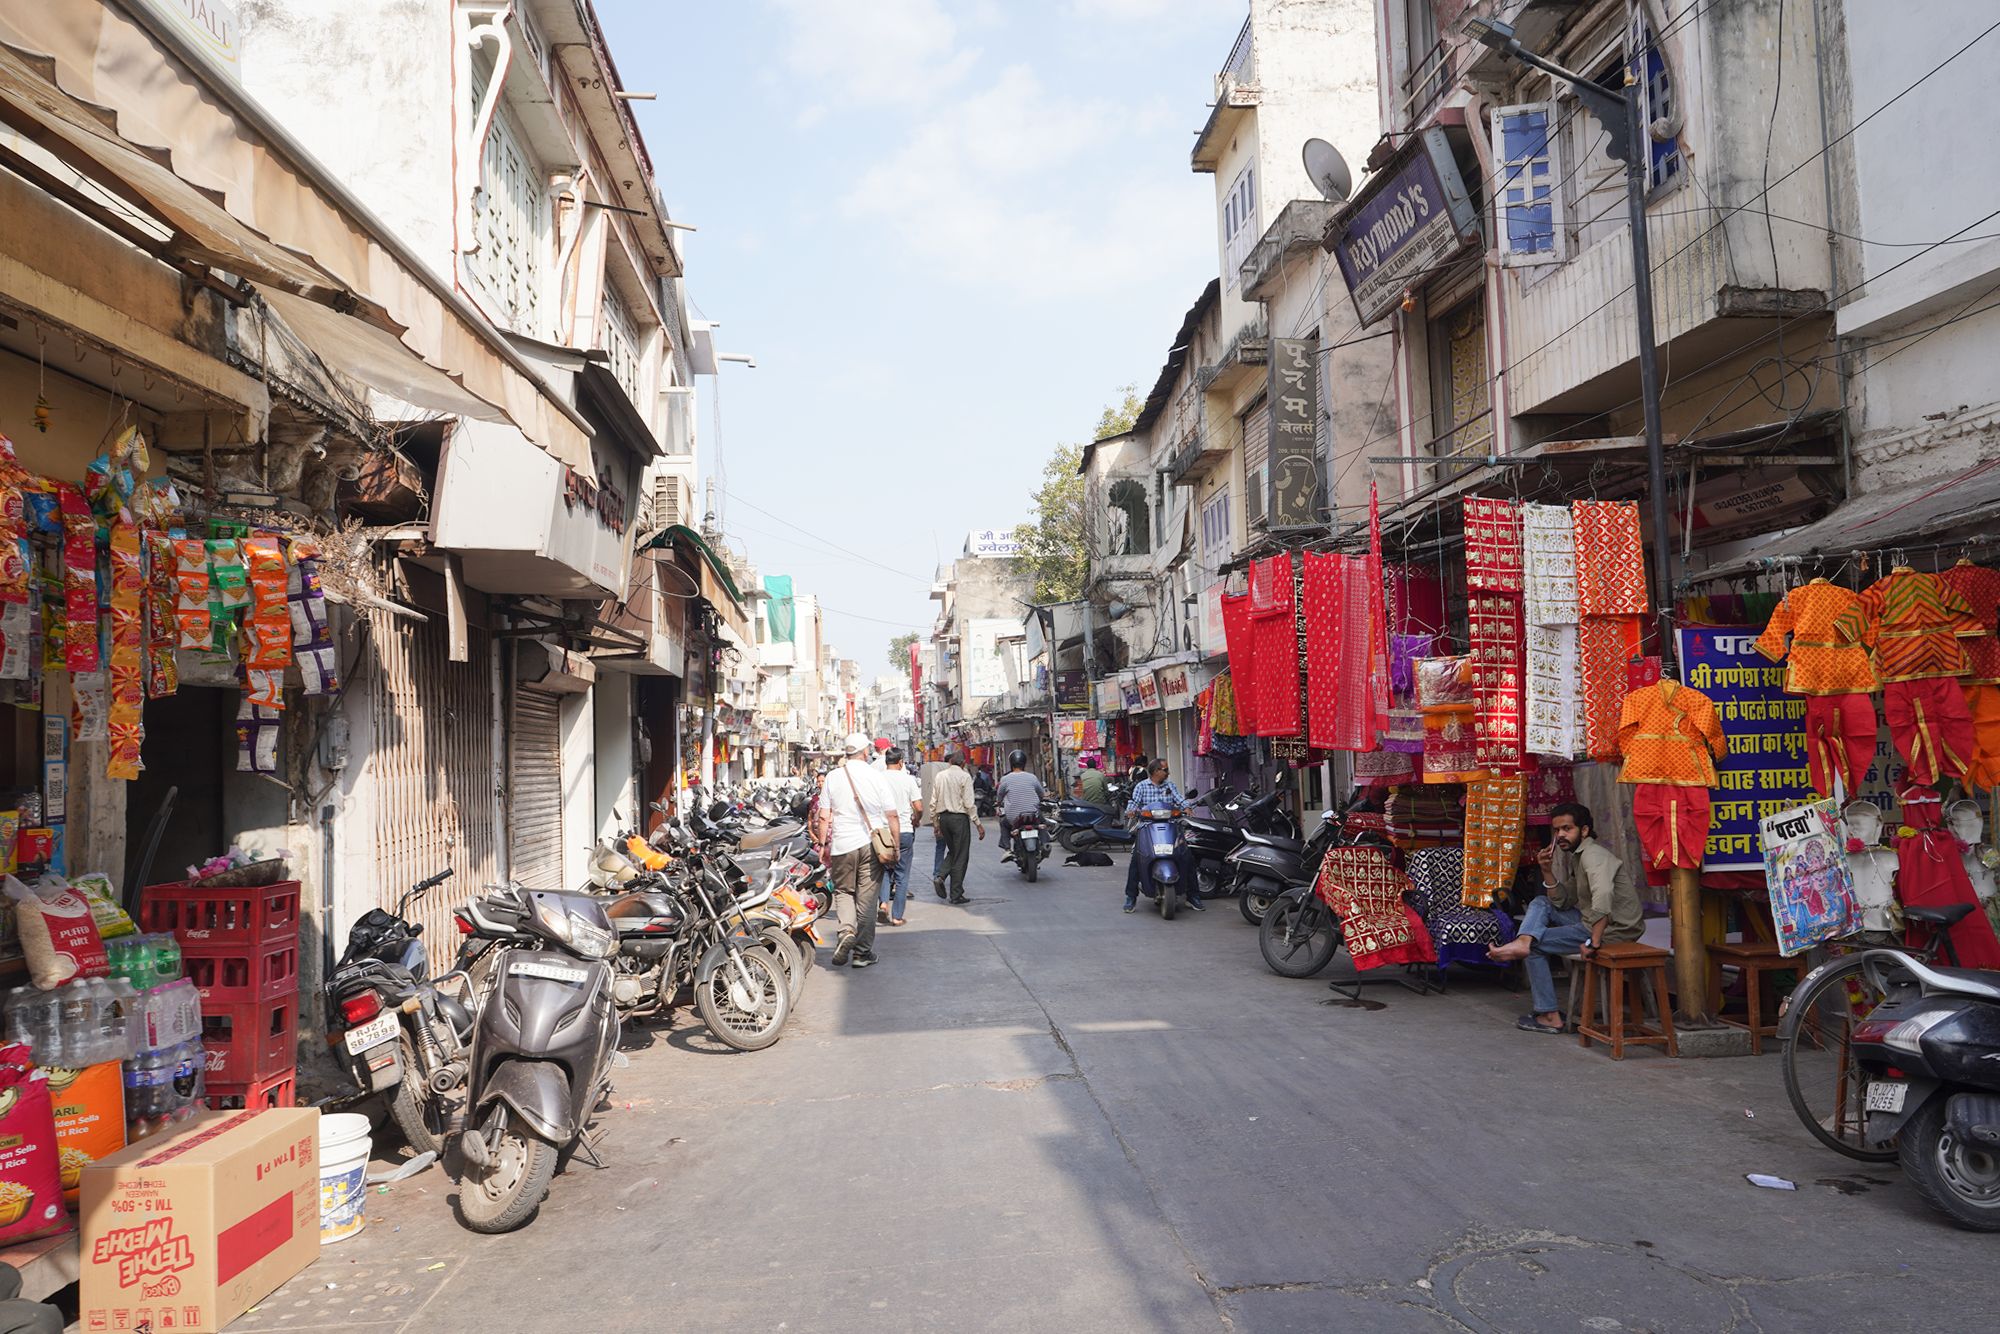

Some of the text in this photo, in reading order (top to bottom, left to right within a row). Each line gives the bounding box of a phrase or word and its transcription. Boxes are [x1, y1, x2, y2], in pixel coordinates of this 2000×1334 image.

[183, 0, 229, 48] JALI
[1277, 419, 1315, 435] ज्वेलर्स
[1690, 662, 1787, 688] श्री गणेश स्था
[1725, 695, 1739, 720] के
[1740, 694, 1767, 720] पटले
[1768, 700, 1784, 719] का
[1785, 700, 1807, 719] साम
[1727, 734, 1760, 753] राजा
[1762, 733, 1781, 752] का
[1715, 770, 1755, 790] वाह
[1704, 834, 1752, 855] हवन
[60, 926, 90, 939] PUFFED
[69, 937, 89, 947] RICE
[356, 1020, 385, 1037] RJ27
[367, 1024, 396, 1041] 7898
[54, 1106, 79, 1117] ARL
[55, 1114, 100, 1128] lden Sella
[68, 1126, 90, 1136] Rice
[0, 1138, 18, 1147] OME
[15, 1143, 37, 1156] Sella
[5, 1157, 27, 1169] Rice
[125, 1190, 159, 1198] NAMKEEN
[111, 1200, 135, 1213] 50%
[145, 1200, 152, 1211] 5
[155, 1198, 173, 1211] TM
[92, 1216, 173, 1265] MEDHE
[118, 1234, 195, 1289] TEDHE
